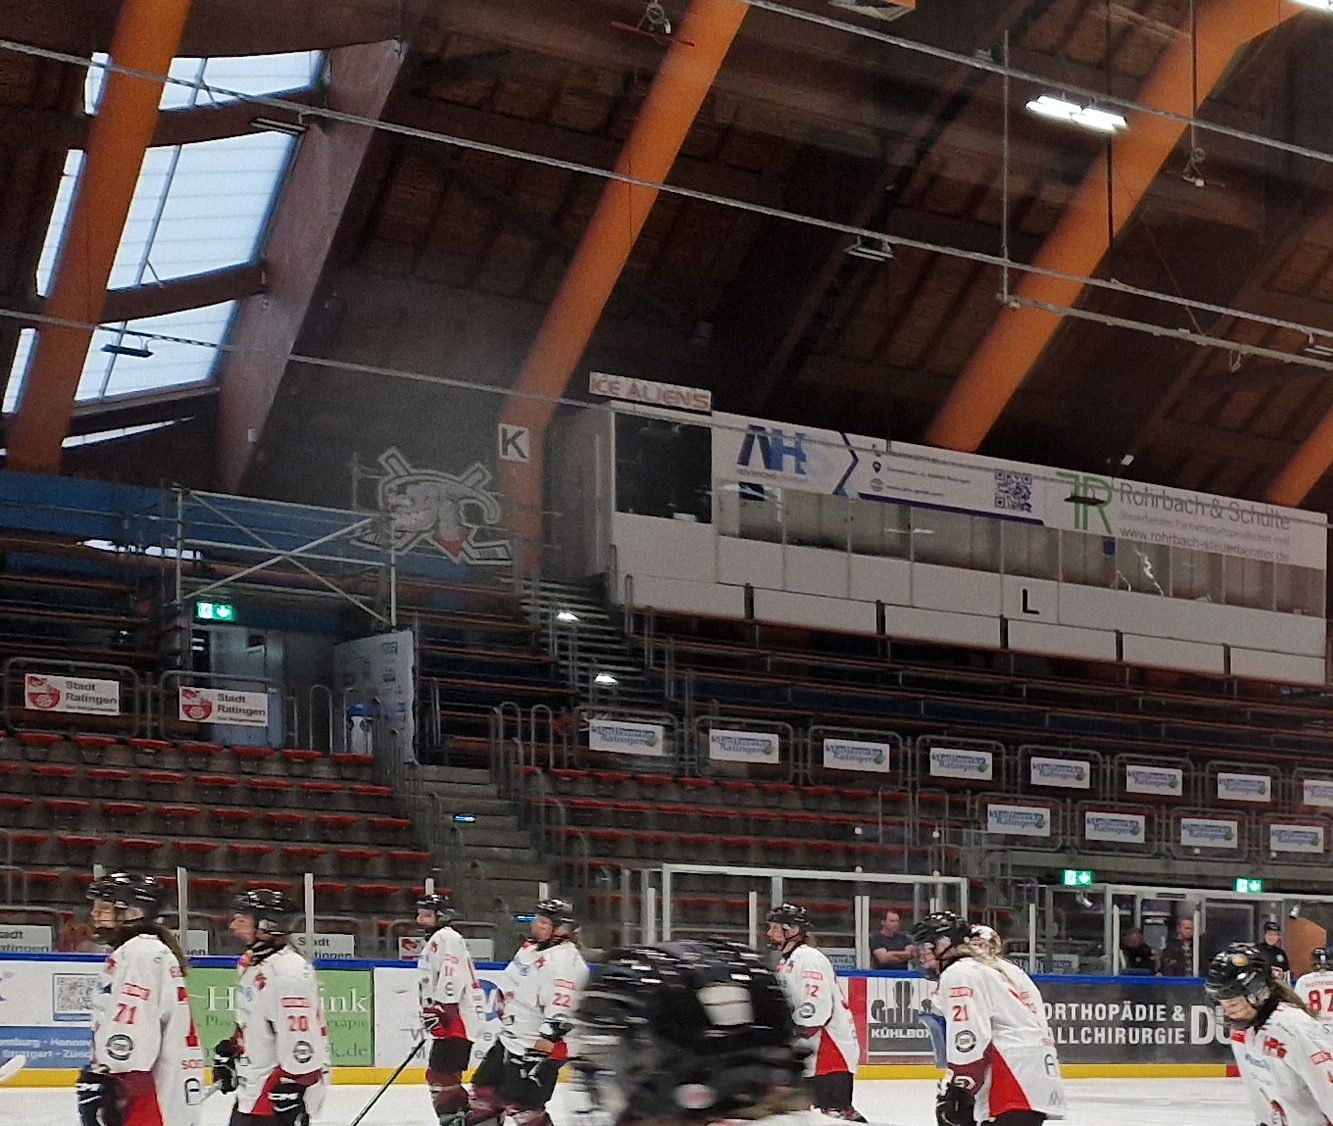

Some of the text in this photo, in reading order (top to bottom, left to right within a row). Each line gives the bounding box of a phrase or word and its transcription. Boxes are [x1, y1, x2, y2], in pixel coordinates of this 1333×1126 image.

[591, 376, 620, 395] ICE
[501, 427, 526, 460] K
[1119, 483, 1290, 530] Rohrbach & Schulte
[1022, 589, 1039, 614] L
[65, 680, 96, 691] Stadt
[66, 692, 117, 705] Ratingen
[217, 693, 246, 703] Stadt
[217, 705, 266, 717] Ratingen
[553, 993, 571, 1007] 22
[113, 1003, 138, 1024] 71
[953, 1005, 969, 1022] 21
[1043, 1001, 1185, 1022] ORTHOPÄDIE &
[288, 1015, 309, 1032] 20
